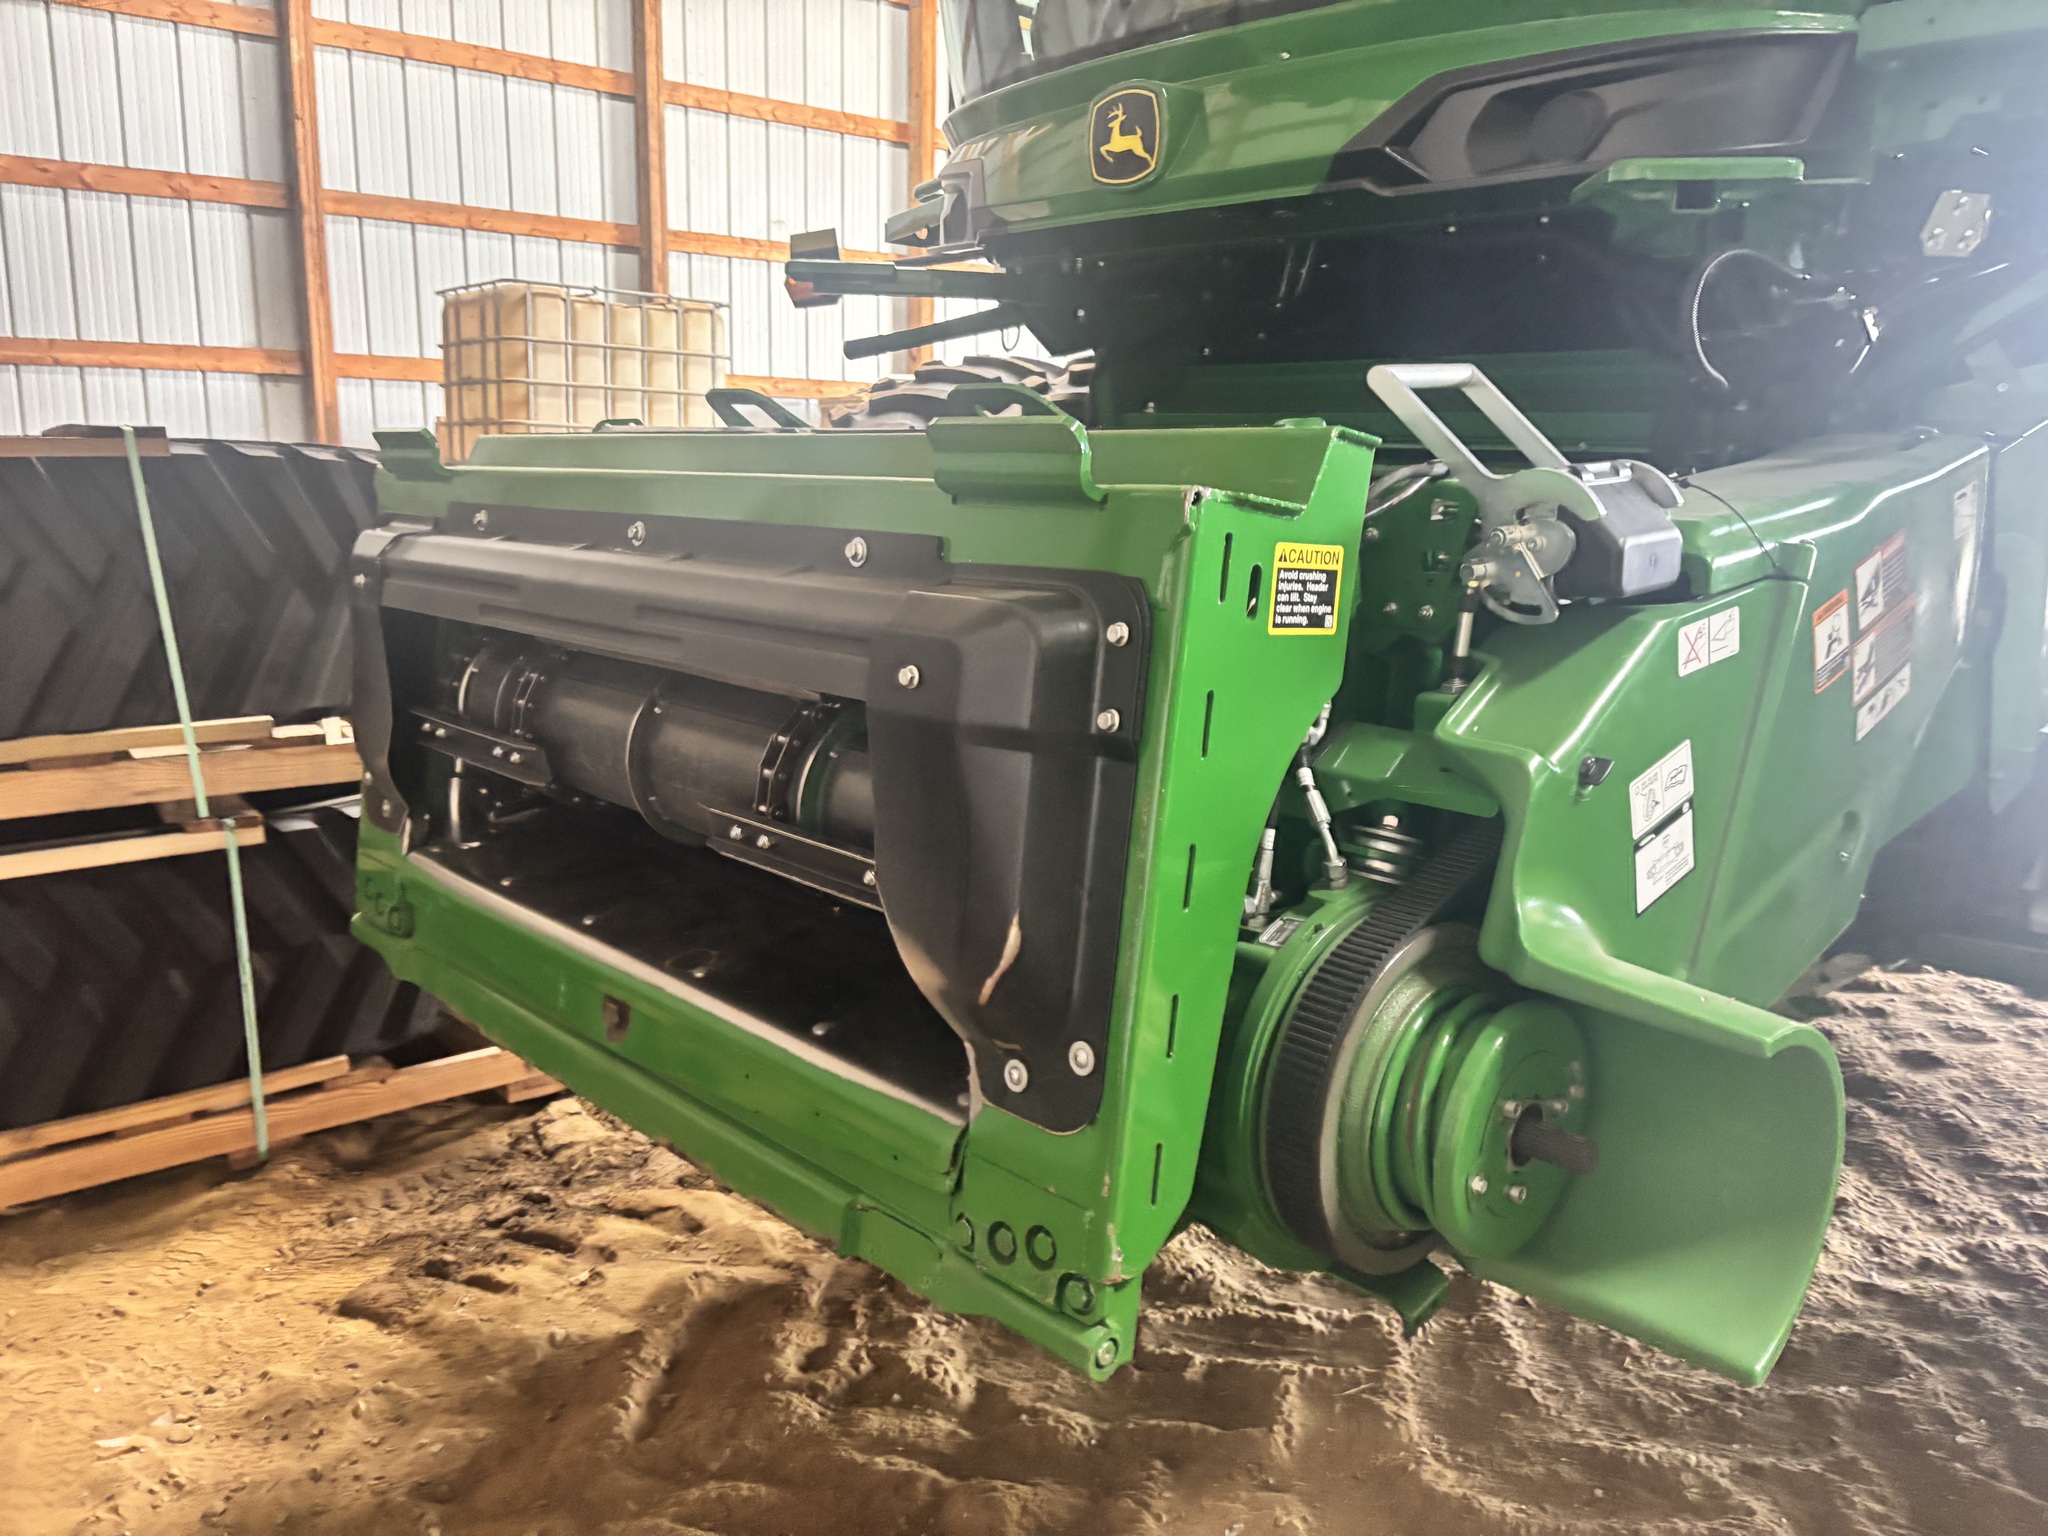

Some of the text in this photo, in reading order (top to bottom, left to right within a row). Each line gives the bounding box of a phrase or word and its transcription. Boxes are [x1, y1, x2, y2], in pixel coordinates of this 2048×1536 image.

[1288, 549, 1340, 565] CAUTION
[1279, 569, 1326, 583] Avoid crushing
[1306, 581, 1328, 592] Header
[1277, 593, 1289, 602] can
[1303, 592, 1317, 604] Stay
[1276, 603, 1332, 615] clear when engine
[1275, 614, 1308, 626] is running.
